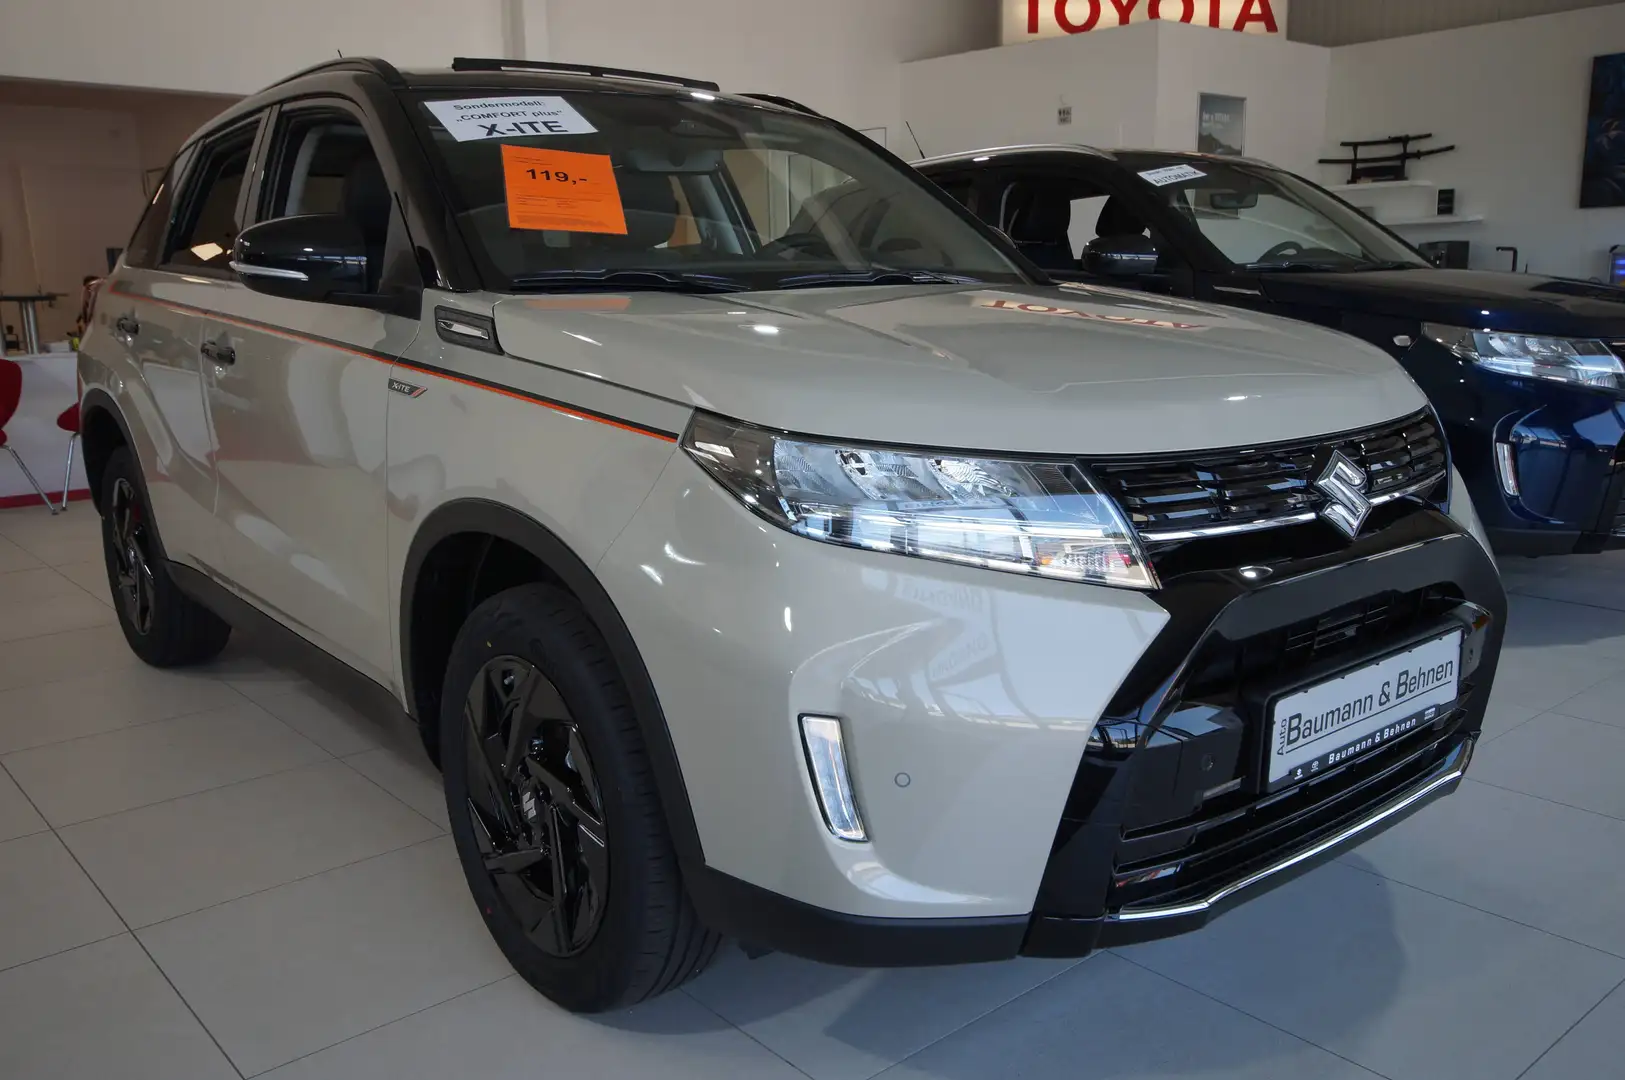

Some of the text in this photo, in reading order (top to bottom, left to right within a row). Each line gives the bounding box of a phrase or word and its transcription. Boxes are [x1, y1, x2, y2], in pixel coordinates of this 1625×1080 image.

[453, 99, 545, 110] Sondermodell:
[477, 120, 568, 136] X-ITE
[526, 168, 588, 185] 119,-
[1287, 660, 1453, 746] Baumann & Behnen
[1276, 718, 1287, 756] Auto
[1328, 717, 1417, 765] Baumann & Behnen
